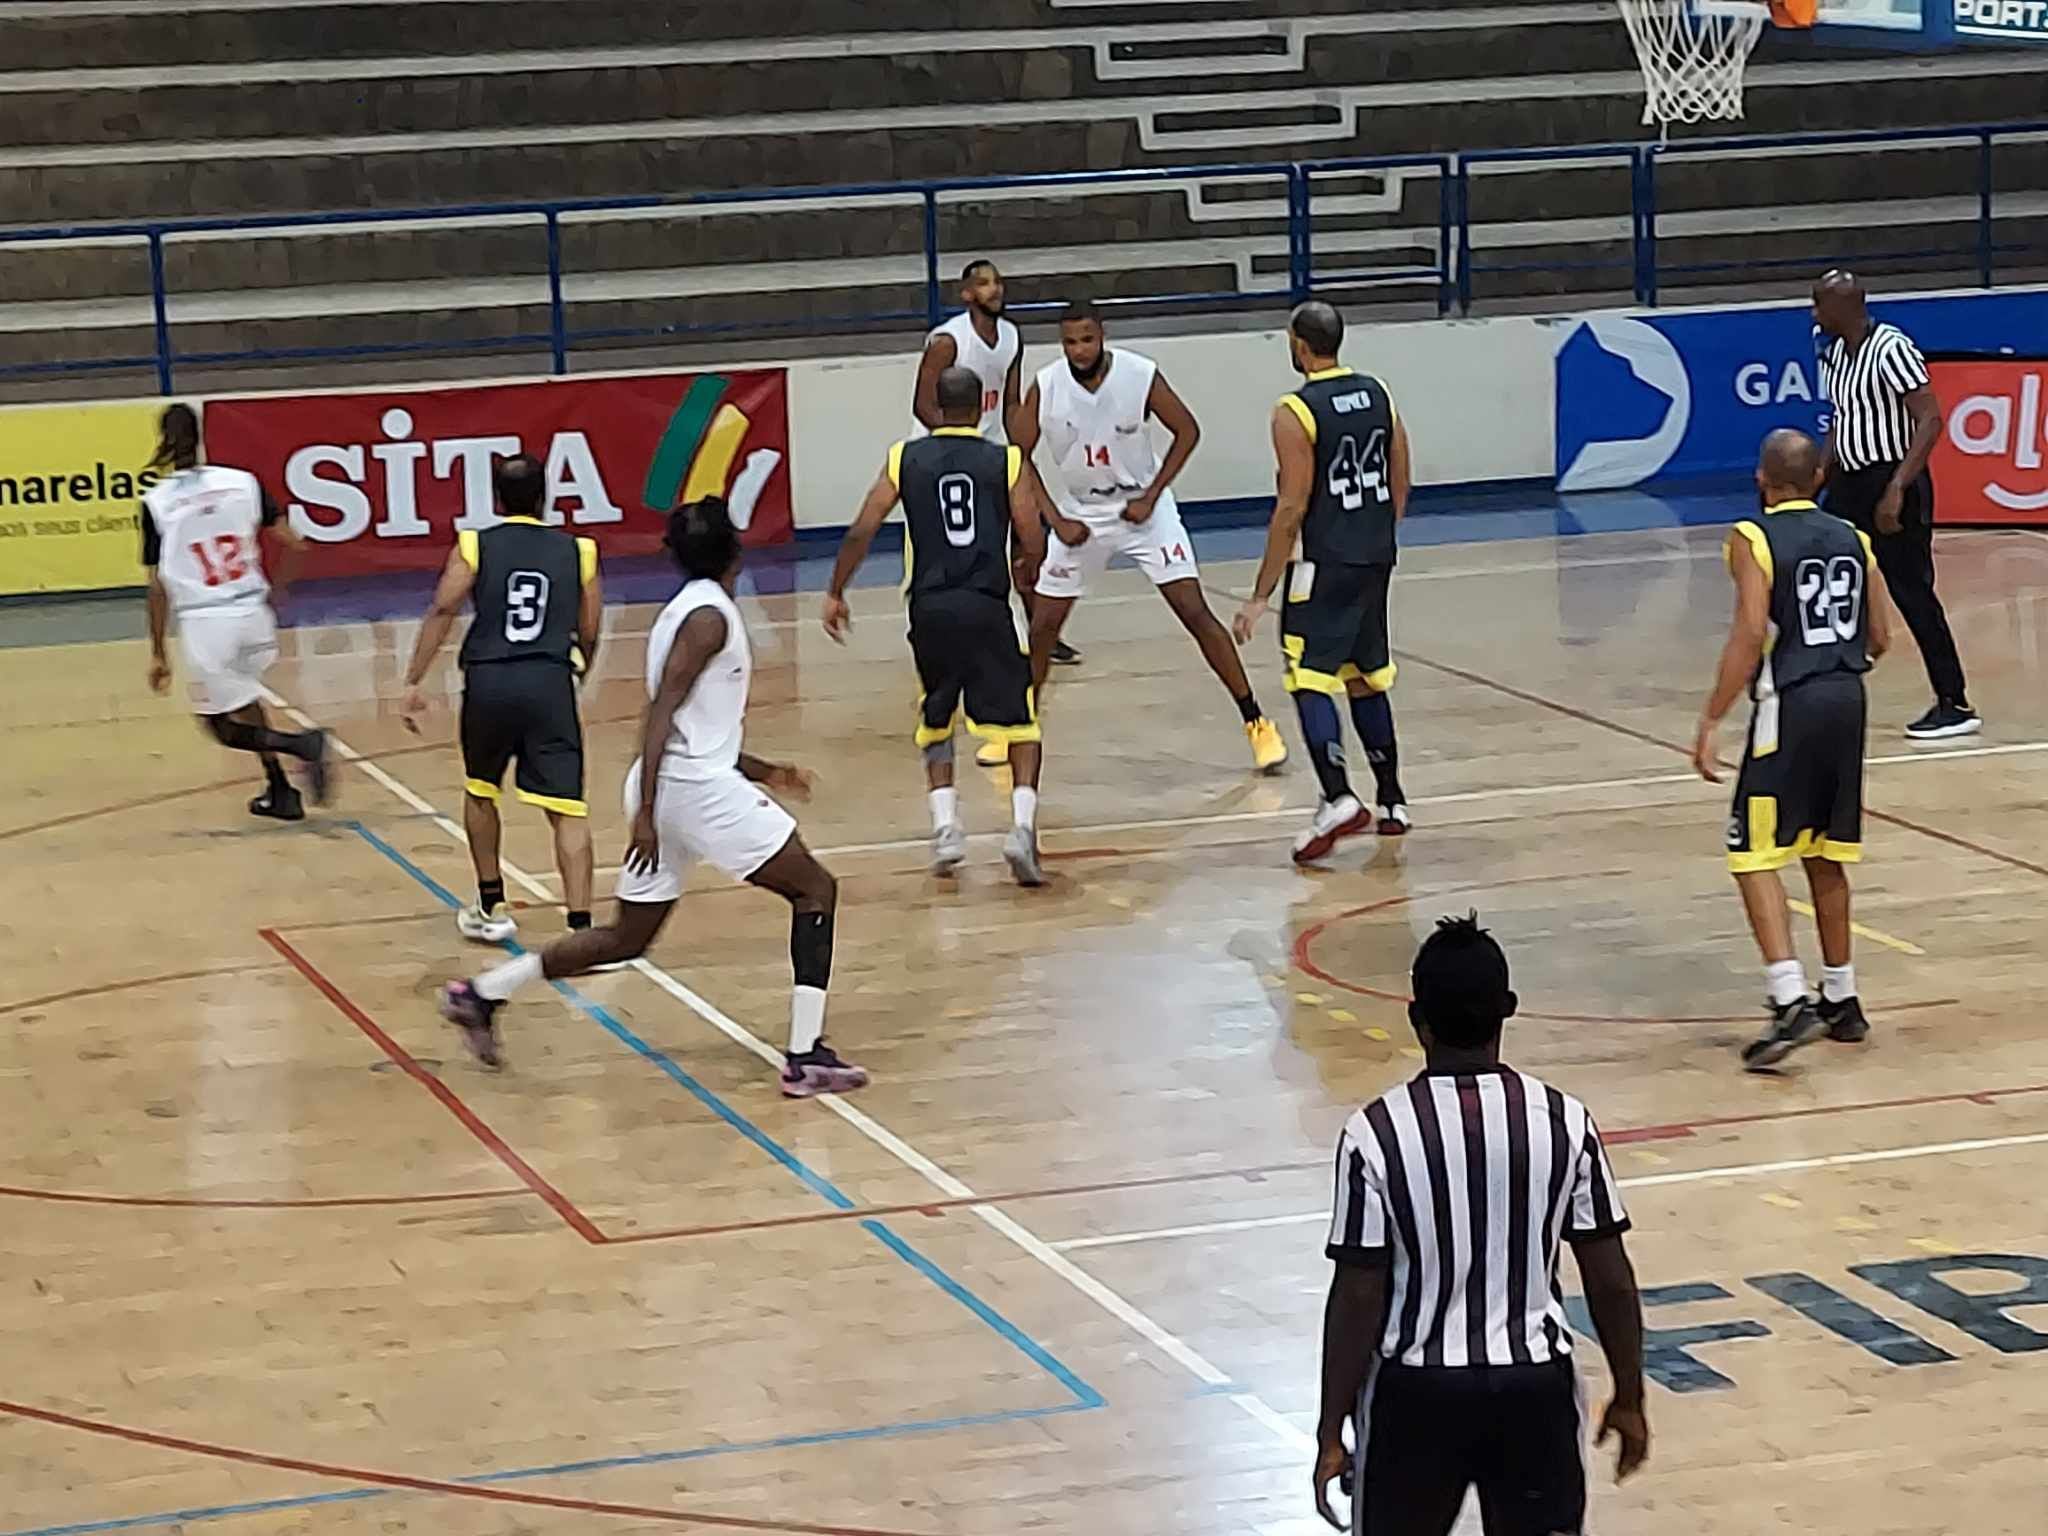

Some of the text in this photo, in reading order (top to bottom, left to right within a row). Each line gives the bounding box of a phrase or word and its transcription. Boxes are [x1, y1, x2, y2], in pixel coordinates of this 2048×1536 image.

[1954, 0, 2048, 28] PORT
[1084, 443, 1110, 467] 14
[1948, 374, 2048, 468] al
[1328, 428, 1390, 510] 44
[939, 472, 975, 547] 8
[190, 534, 246, 586] 12
[1160, 542, 1187, 568] 14
[504, 571, 549, 642] 3
[1796, 556, 1863, 646] 23
